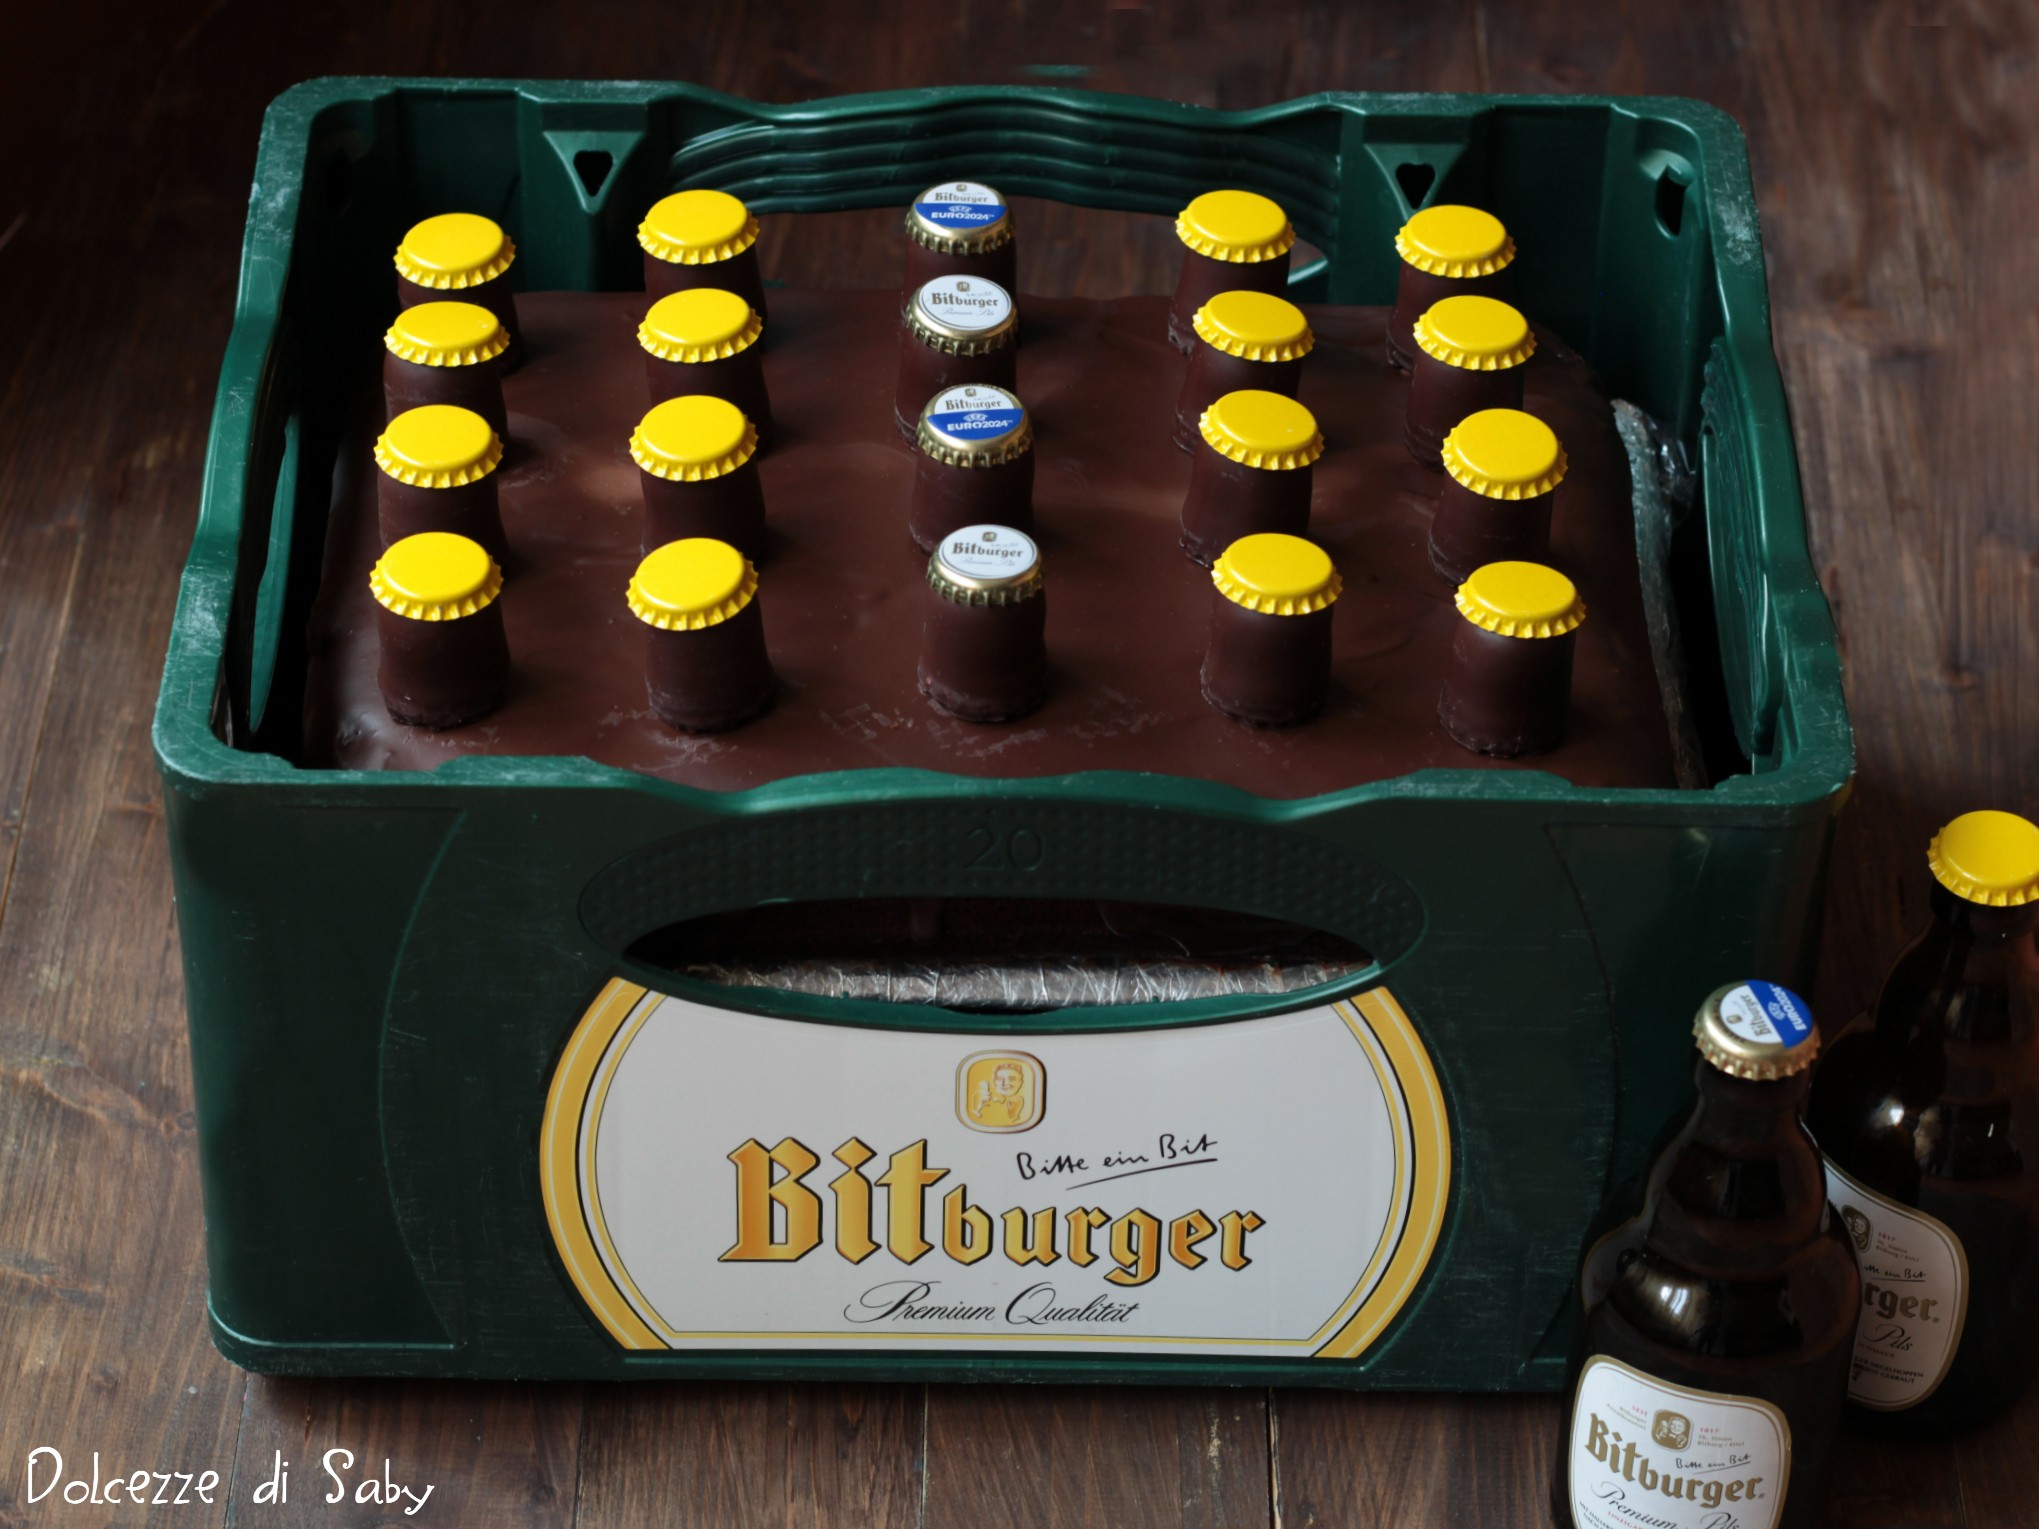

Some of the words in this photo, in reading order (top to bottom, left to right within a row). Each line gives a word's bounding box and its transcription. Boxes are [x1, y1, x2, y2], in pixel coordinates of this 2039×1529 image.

[931, 292, 998, 308] Bitburger
[945, 398, 1001, 411] Bitburger
[952, 542, 1024, 558] Bitburger
[965, 825, 1046, 873] 20
[1017, 1151, 1089, 1181] Bitte
[1103, 1151, 1149, 1168] ein
[1159, 1133, 1218, 1160] Bit
[717, 1136, 1267, 1288] Bitburger
[844, 1280, 995, 1323] Premium
[1005, 1281, 1140, 1325] Qualität
[1864, 1281, 1938, 1322] rger
[1862, 1323, 1912, 1351] Pils
[1585, 1413, 1763, 1509] Bitburger
